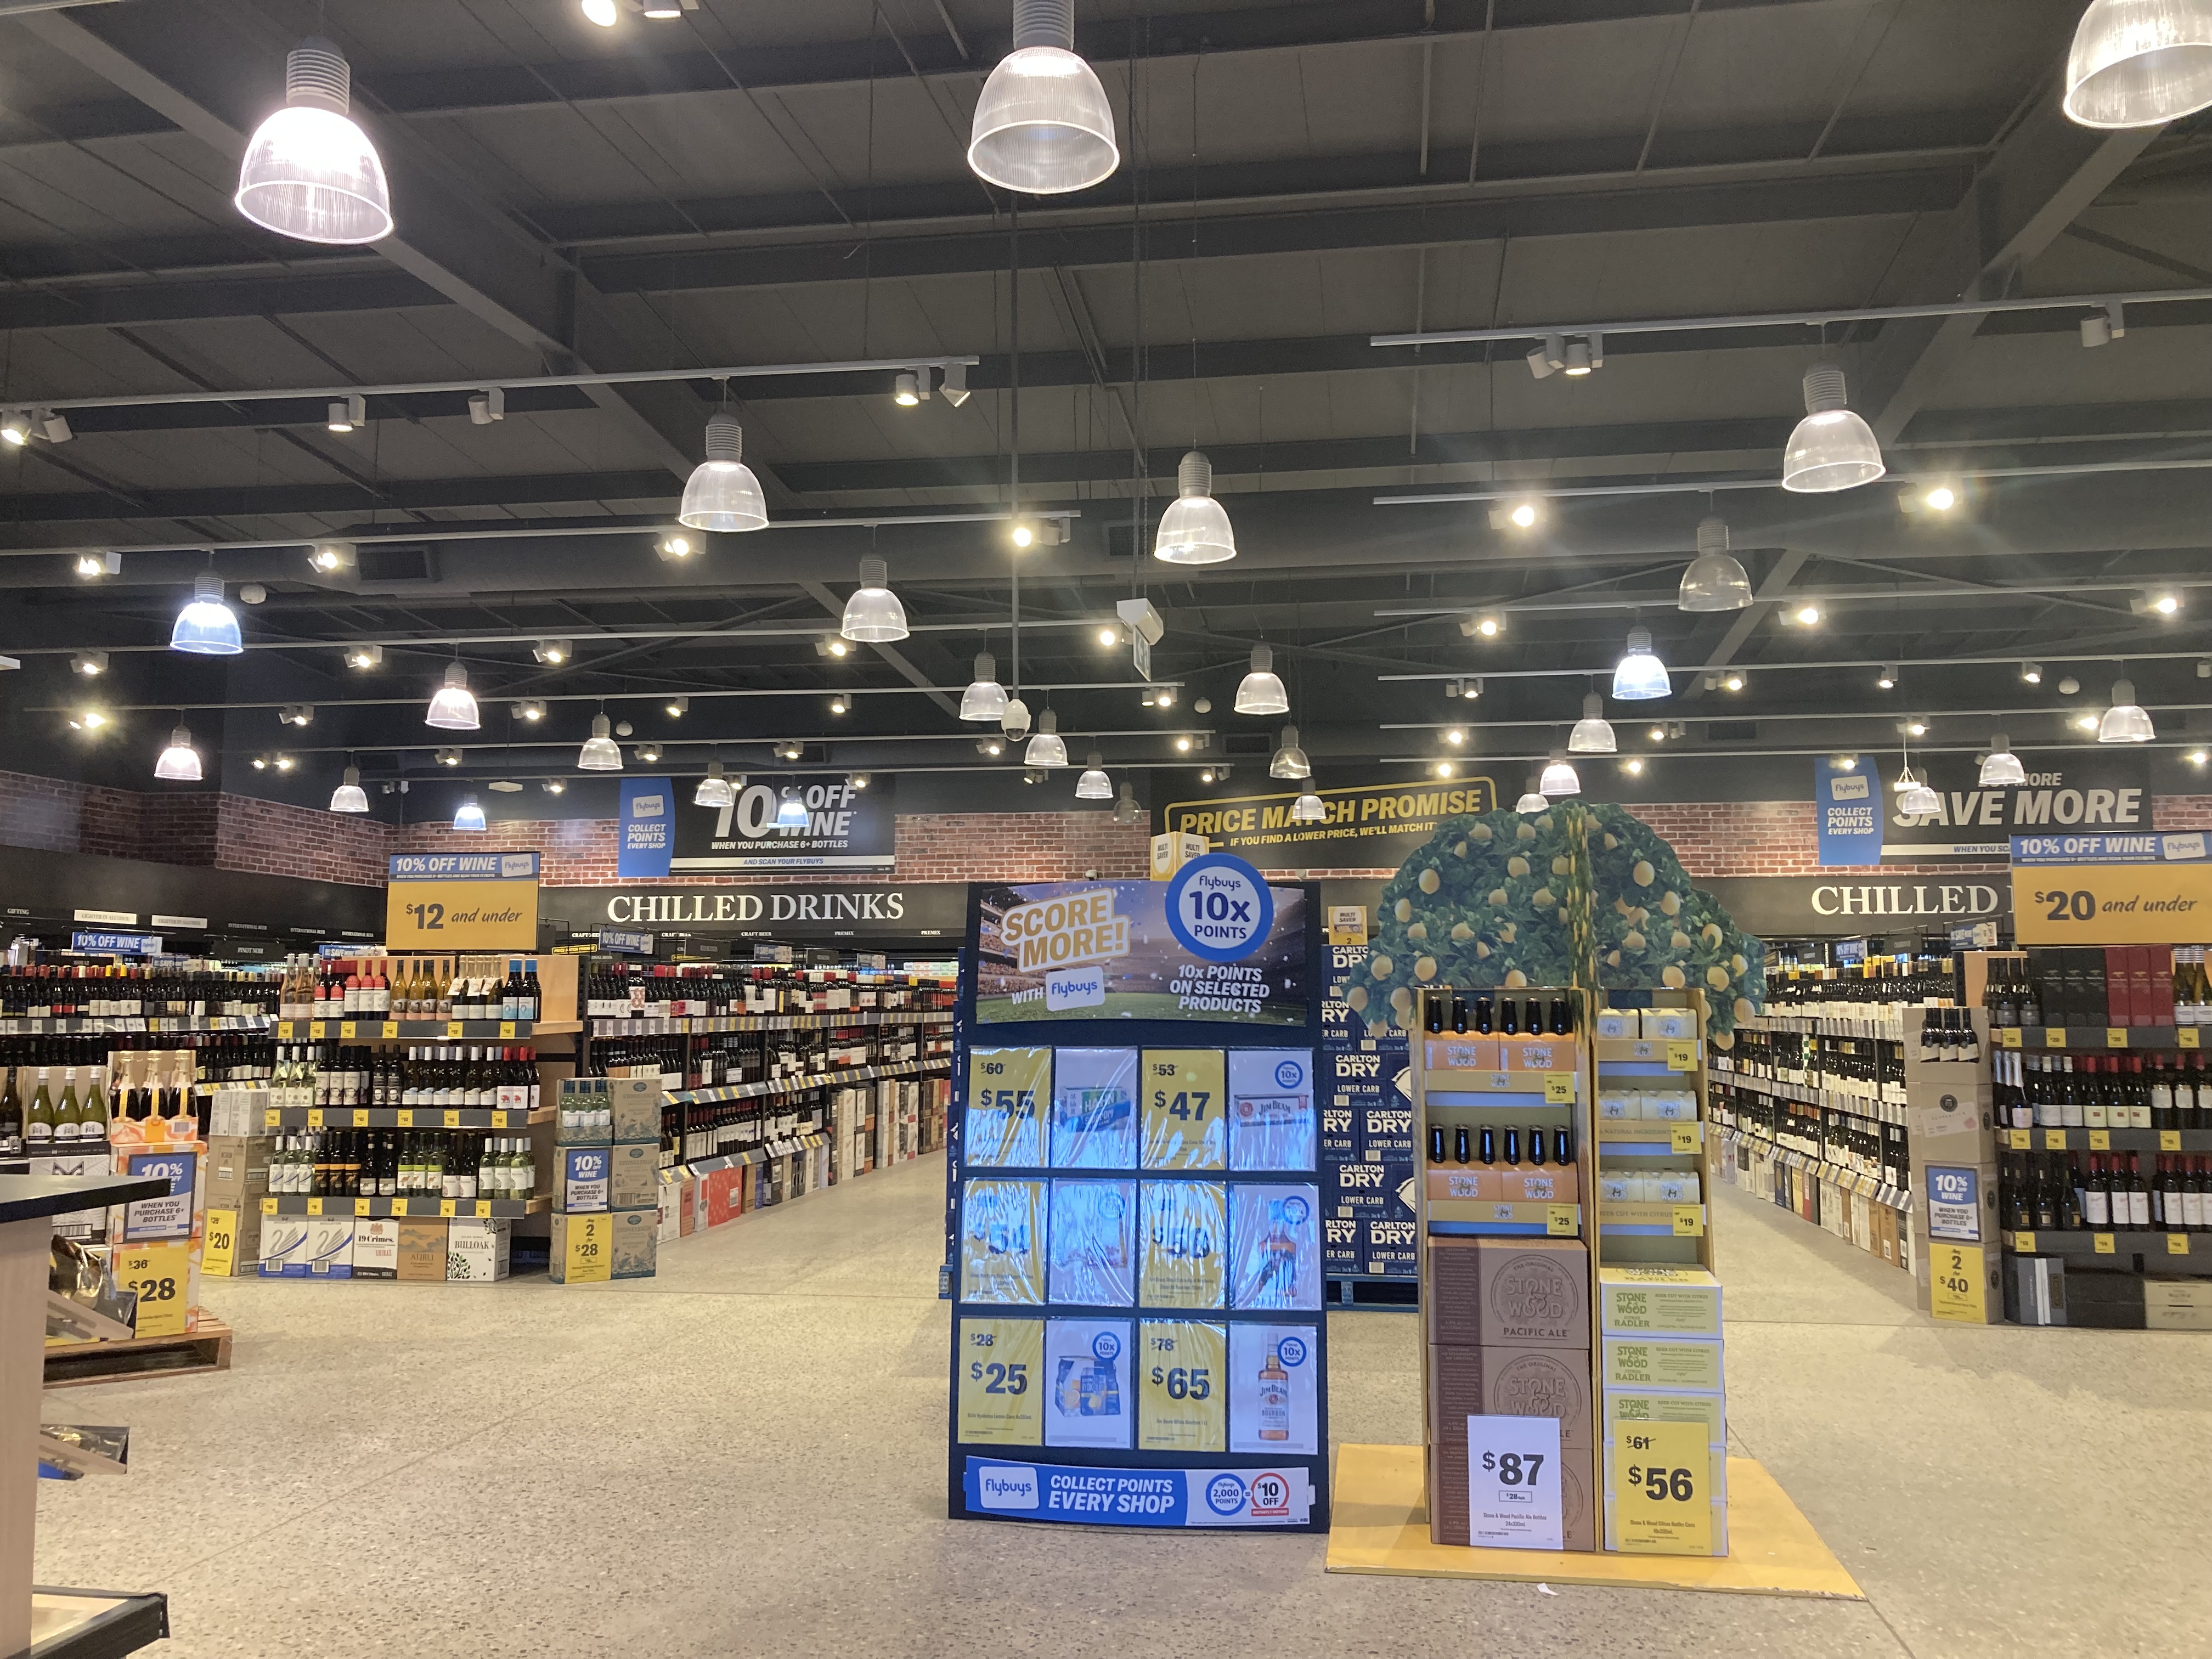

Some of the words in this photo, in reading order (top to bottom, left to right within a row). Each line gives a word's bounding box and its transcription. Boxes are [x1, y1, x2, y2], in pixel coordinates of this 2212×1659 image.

[1835, 783, 1865, 794] flybuys
[806, 784, 857, 809] OFF
[635, 802, 661, 812] flybuys
[1180, 808, 1257, 835] PRICE
[1361, 789, 1482, 822] PROMISE
[1827, 806, 1872, 817] COLLECT
[1893, 791, 2006, 827] SAVE
[2014, 788, 2142, 825] MORE
[628, 823, 666, 833] COLLECT
[1827, 816, 1872, 827] POINTS
[627, 832, 666, 842] POINTS
[1230, 837, 1239, 847] IF
[1241, 836, 1261, 846] YOU
[1261, 833, 1283, 844] FIND
[1284, 833, 1292, 842] A
[1293, 830, 1326, 842] LOWER
[1327, 828, 1358, 839] PRICE,
[1359, 826, 1387, 836] WE'LL
[1389, 823, 1423, 834] MATCH
[712, 841, 737, 850] WHEN
[737, 841, 756, 849] YOU
[757, 840, 799, 849] PURCHASE
[811, 840, 848, 848] BOTTLES
[1158, 843, 1168, 852] MULTI
[1186, 843, 1200, 851] MULTI
[2020, 838, 2060, 854] 10%
[2064, 837, 2102, 854] OFF
[2106, 837, 2157, 853] WINE
[2167, 842, 2200, 853] flybuys
[1157, 851, 1169, 860] SAVER
[397, 857, 426, 872] 10%
[428, 857, 457, 871] OFF
[459, 856, 498, 871] WINE
[505, 861, 529, 870] flybuys
[1199, 875, 1241, 891] flybuys
[607, 895, 763, 923] CHILLED
[770, 892, 904, 922] DRINKS
[1189, 890, 1251, 923] 10x
[1811, 886, 1999, 915] CHILLED
[2035, 890, 2096, 921] $20
[2102, 895, 2140, 913] and
[2143, 895, 2198, 913] under
[406, 901, 444, 929] $12
[452, 907, 480, 923] and
[482, 907, 523, 923] under
[1005, 895, 1108, 941] SCORE
[1194, 924, 1246, 939] POINTS
[77, 934, 96, 947] 10%
[98, 935, 116, 948] OFF
[116, 936, 141, 949] WINE
[1023, 922, 1124, 968] MORE!
[1178, 964, 1205, 979] 10x
[1207, 965, 1262, 982] POINTS
[1012, 986, 1044, 1005] WITH
[1051, 981, 1098, 998] flybuys
[1170, 979, 1193, 994] ON
[1194, 980, 1271, 998] SELECTED
[1178, 996, 1262, 1014] PRODUCTS
[1447, 1046, 1476, 1056] STONE
[1335, 1054, 1380, 1063] CARLTON
[1448, 1058, 1476, 1067] WOOD
[980, 1062, 1004, 1075] $60
[1153, 1063, 1176, 1076] $53
[1280, 1070, 1297, 1079] 10x
[1335, 1063, 1380, 1077] DRY
[1337, 1085, 1360, 1093] LOWER
[1362, 1085, 1380, 1093] CARB
[1551, 1085, 1566, 1094] $25
[981, 1087, 1035, 1120] $55
[1154, 1090, 1210, 1121] $47
[1260, 1103, 1272, 1114] JIM
[1272, 1100, 1290, 1113] BEAM
[1678, 1135, 1691, 1144] $19
[574, 1155, 602, 1171] 10%
[1935, 1175, 1968, 1192] 10%
[1941, 1192, 1963, 1201] WINE
[140, 1201, 163, 1209] WHEN
[586, 1224, 595, 1237] 2
[1370, 1221, 1415, 1230] CARLTON
[209, 1232, 230, 1250] $20
[1370, 1229, 1415, 1245] DRY
[454, 1240, 489, 1249] BULLOAK
[575, 1243, 598, 1257] $28
[1372, 1251, 1396, 1260] LOWER
[1397, 1251, 1415, 1260] CARB
[1952, 1255, 1962, 1270] 2
[1507, 1277, 1563, 1297] STONE
[1939, 1276, 1968, 1293] $40
[1616, 1293, 1646, 1303] STONE
[1509, 1302, 1563, 1318] WOOD
[1617, 1304, 1647, 1314] WOOD
[1614, 1319, 1650, 1328] RADLER
[1503, 1327, 1545, 1337] PACIFIC
[1098, 1342, 1115, 1351] 10x
[1151, 1338, 1175, 1351] $78
[1283, 1347, 1301, 1356] 10x
[970, 1360, 1028, 1395] $25
[1152, 1365, 1210, 1400] $65
[1260, 1385, 1271, 1397] JIM
[1271, 1384, 1288, 1394] BEAM
[1626, 1436, 1650, 1450] $61
[1482, 1450, 1544, 1486] $87
[985, 1478, 1032, 1497] flybuys
[1049, 1474, 1116, 1492] COLLECT
[1116, 1477, 1173, 1494] POINTS
[1257, 1482, 1279, 1497] $10
[1628, 1464, 1694, 1502] $56
[1213, 1489, 1239, 1498] 2,000
[1048, 1490, 1115, 1512] EVERY
[1116, 1493, 1175, 1514] SHOP
[1263, 1497, 1279, 1505] OFF
